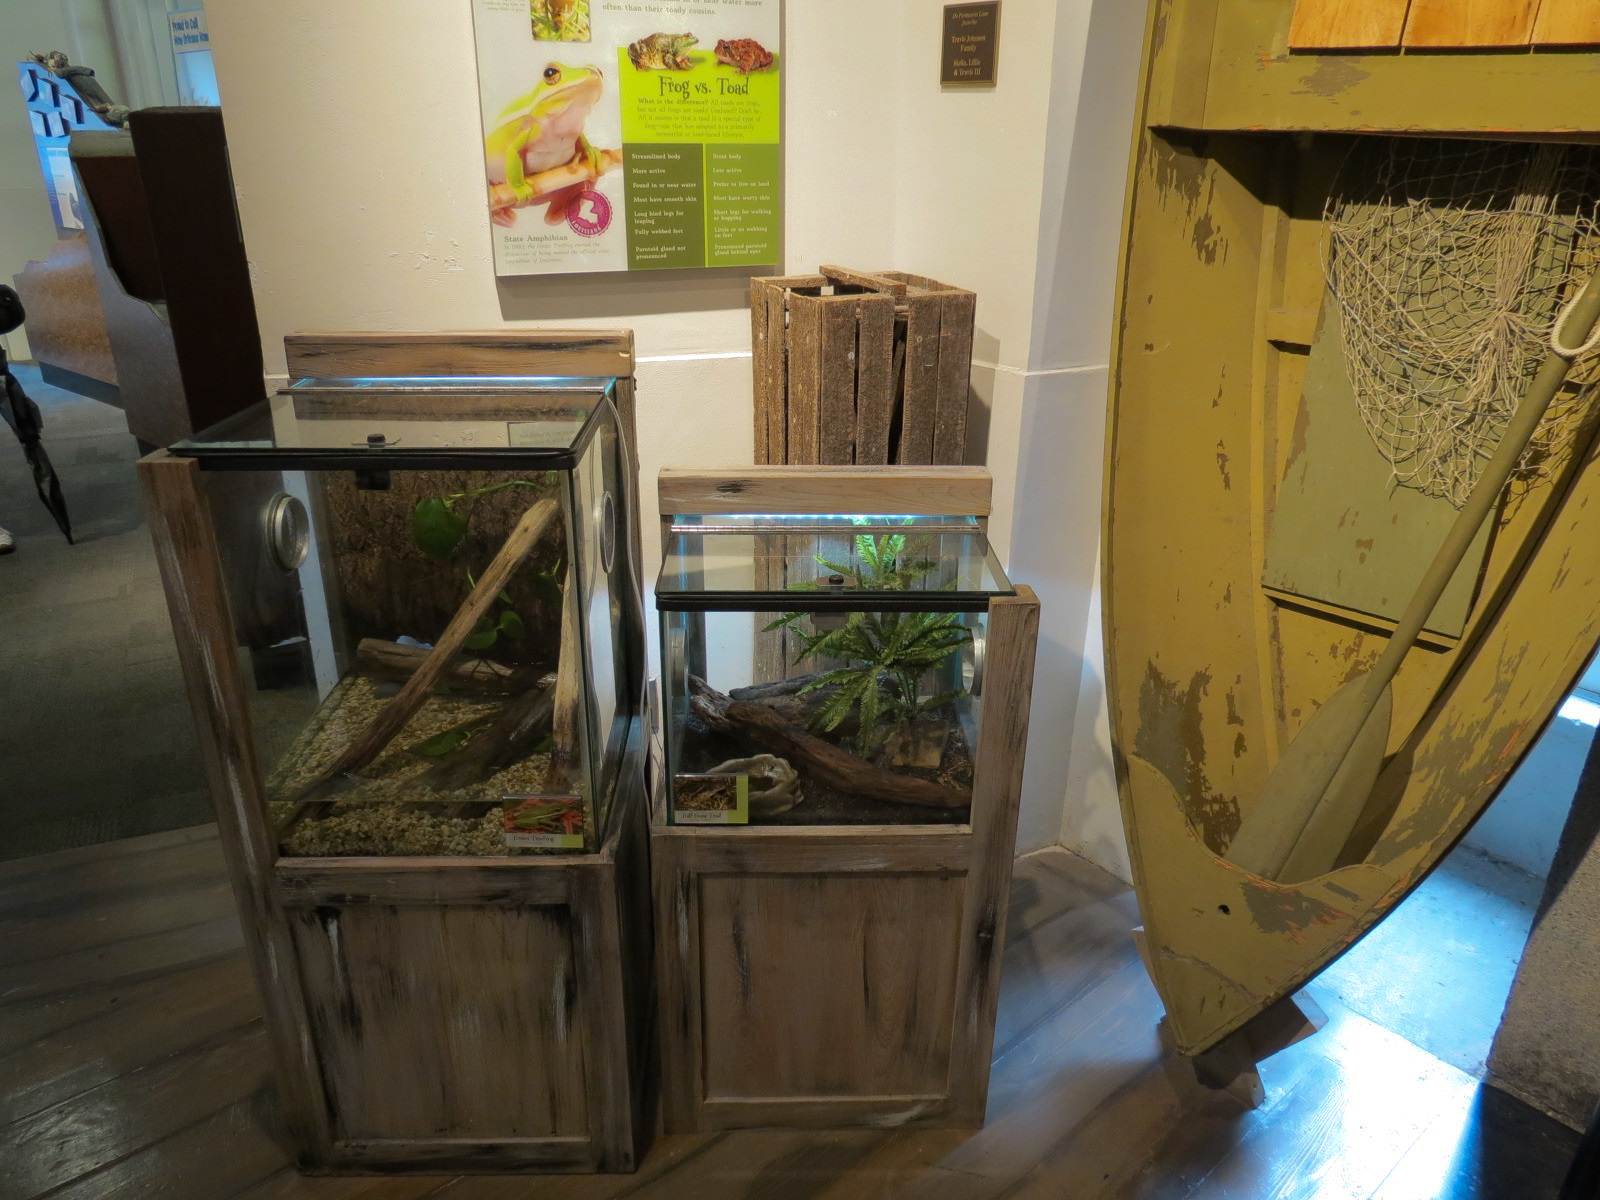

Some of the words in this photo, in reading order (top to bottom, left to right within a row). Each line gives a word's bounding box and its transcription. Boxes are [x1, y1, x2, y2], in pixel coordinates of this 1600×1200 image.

[624, 4, 642, 12] than
[644, 4, 664, 12] their
[666, 6, 686, 14] toady
[658, 75, 690, 100] Frog
[695, 82, 712, 95] vs.
[716, 76, 749, 95] Toad
[571, 220, 602, 235] LOUISIANA
[527, 234, 568, 243] Amphibian
